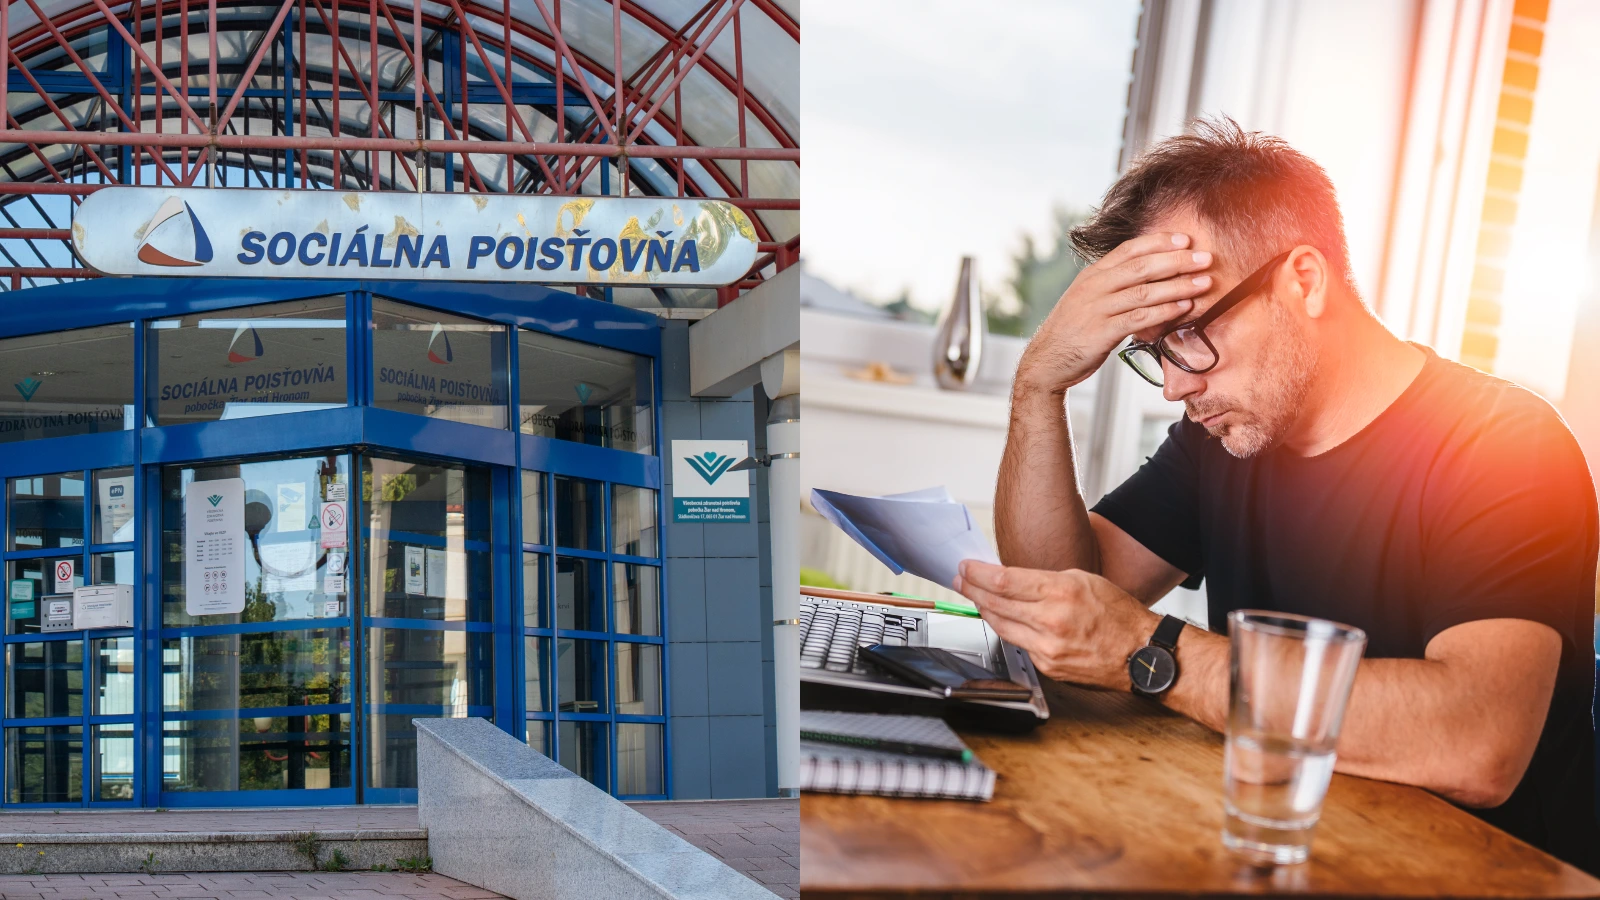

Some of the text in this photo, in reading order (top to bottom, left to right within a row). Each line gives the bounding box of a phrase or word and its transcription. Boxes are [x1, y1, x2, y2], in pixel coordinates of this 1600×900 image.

[236, 224, 700, 273] SOCIÁLNA POISŤOVŇA
[160, 362, 335, 401] SOCIÁLNA POISŤOVŇA
[379, 367, 501, 404] SOCIÁLNA POISŤOVŇA
[184, 398, 226, 415] pobočka
[271, 390, 310, 404] Hronom
